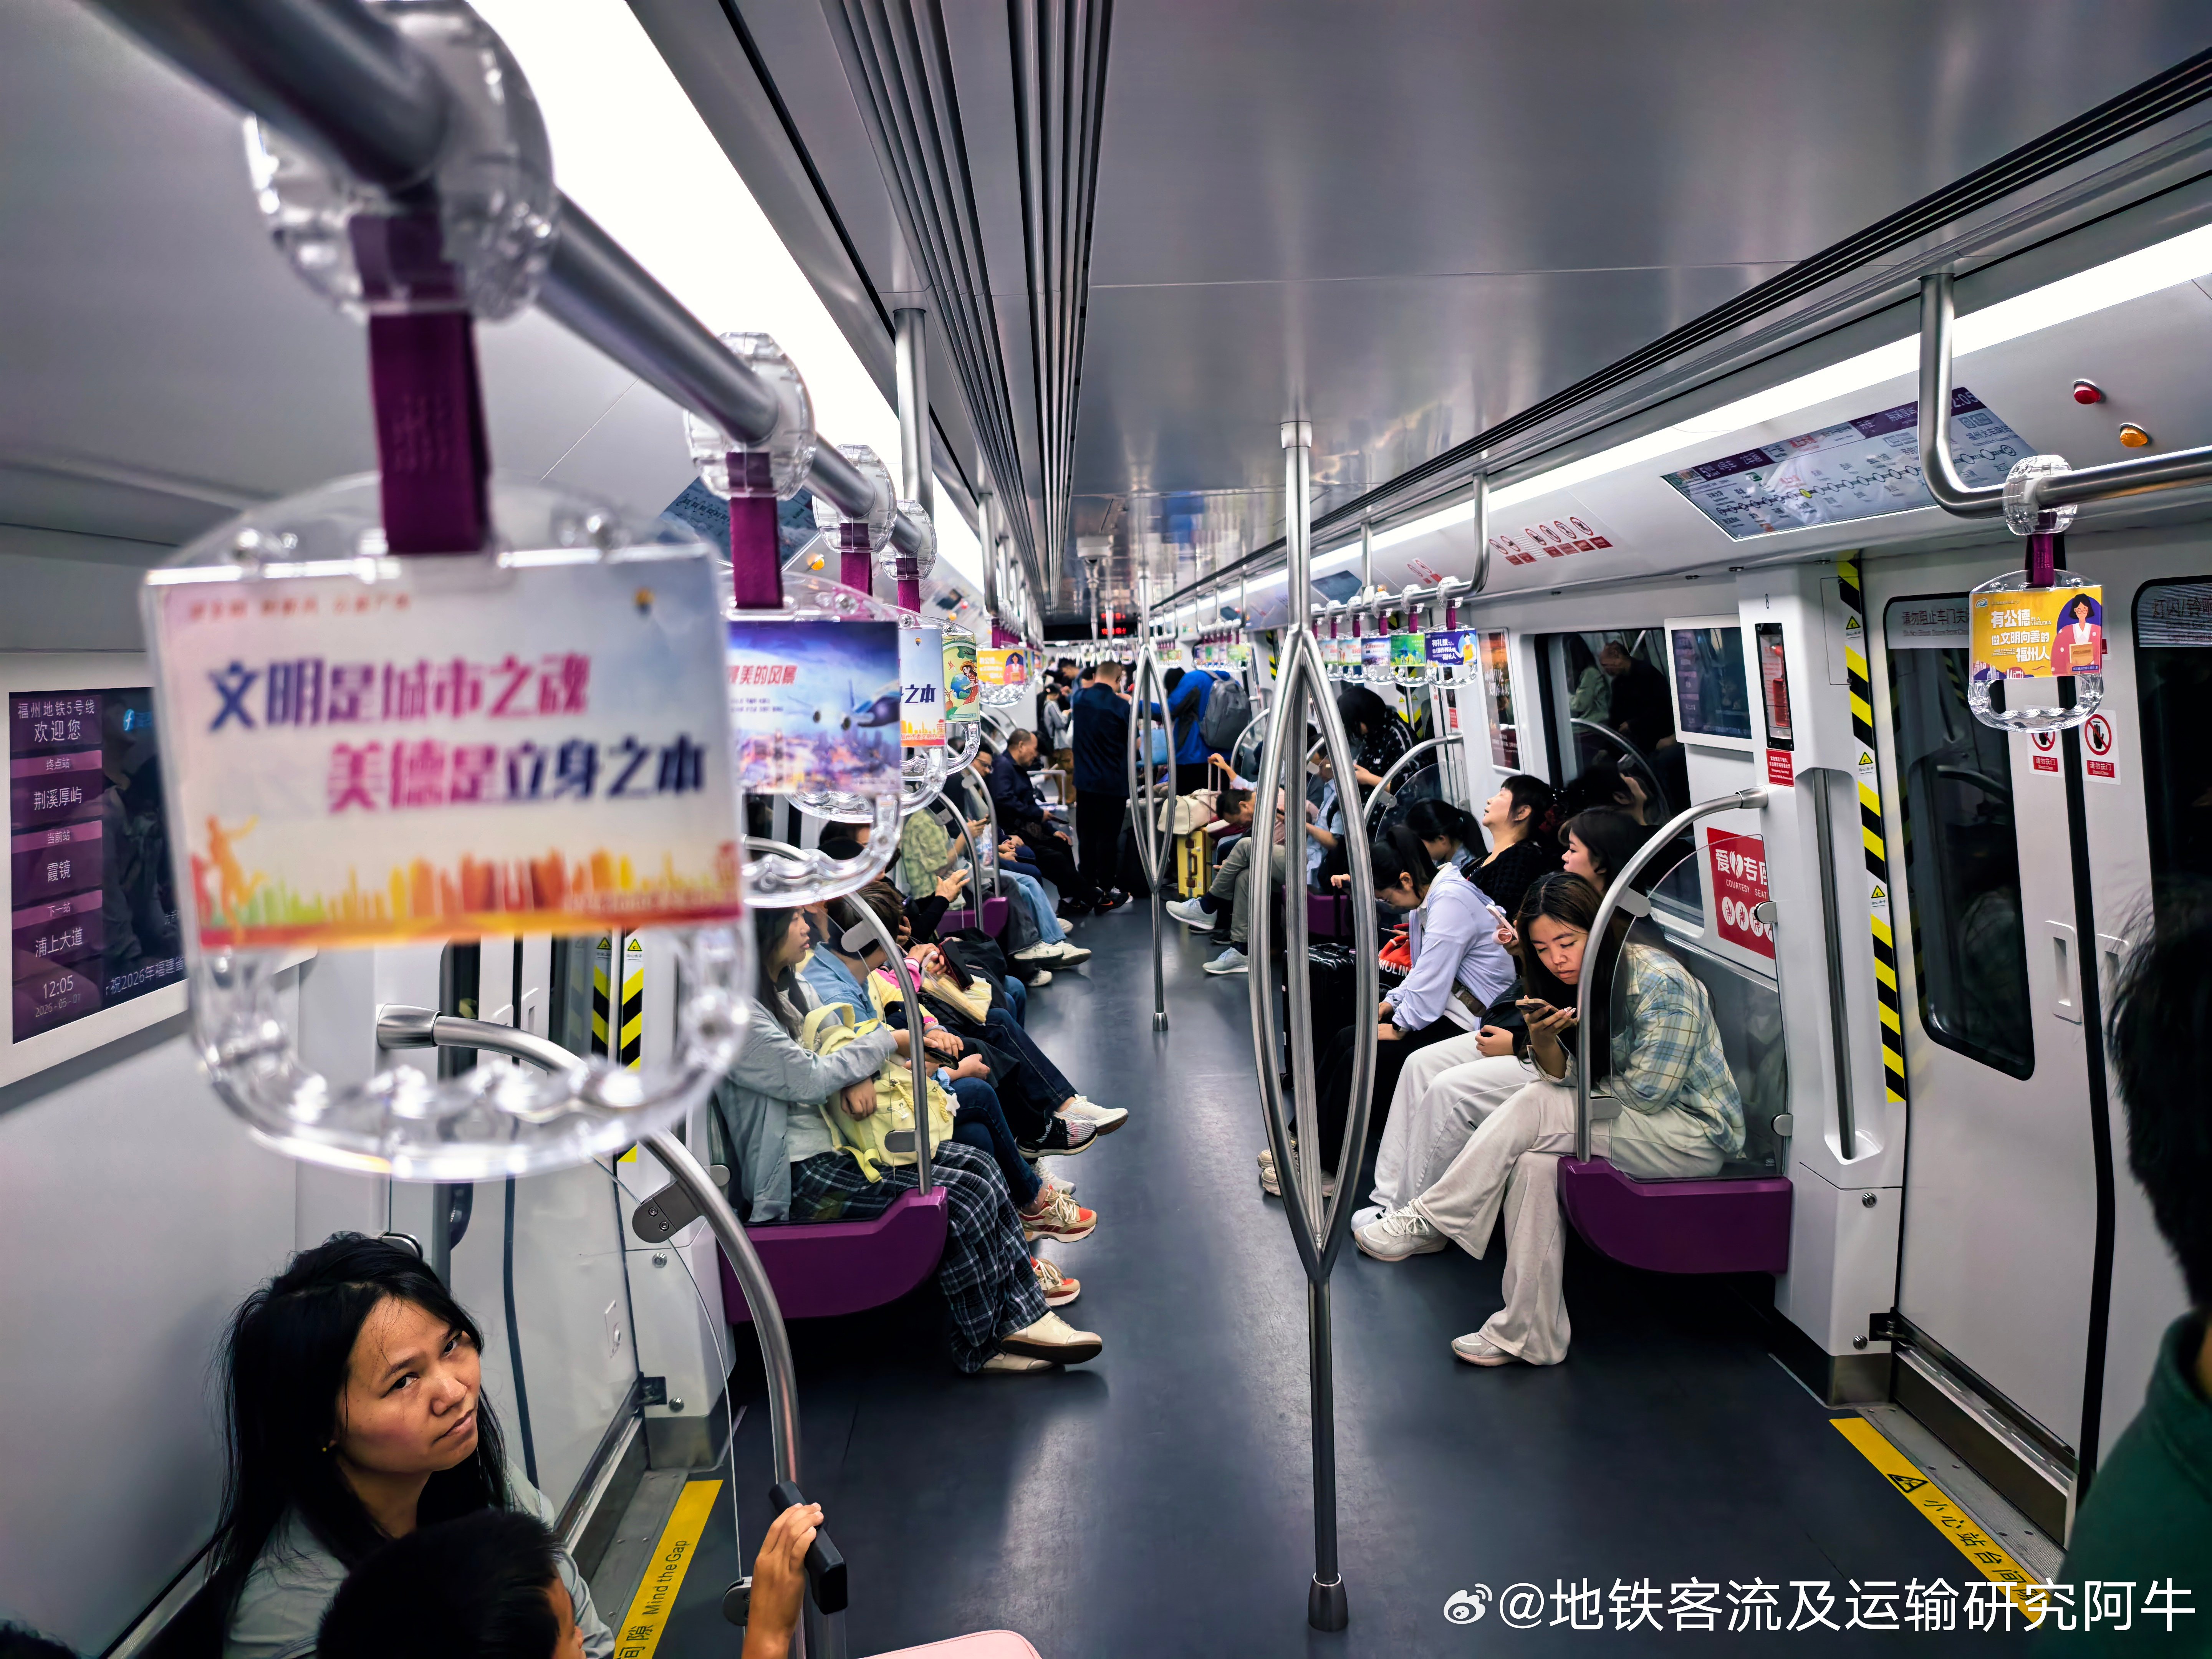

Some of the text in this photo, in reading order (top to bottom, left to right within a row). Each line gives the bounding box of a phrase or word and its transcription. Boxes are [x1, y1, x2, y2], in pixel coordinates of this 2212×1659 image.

[1951, 392, 1979, 409] 2:05
[1991, 609, 2030, 628] 有公德
[1991, 630, 2050, 646] 做文明向善的
[2016, 646, 2050, 662] 福州人
[900, 684, 936, 704] 之本
[18, 699, 95, 719] 福州地铁5号线
[34, 719, 81, 743] 欢迎您
[46, 757, 70, 770] 终点站
[33, 786, 82, 811] 荆溪厚屿
[47, 829, 71, 844] 当前站
[47, 860, 71, 883] 霞镜
[1725, 879, 1767, 899] COURTESY SEAT
[47, 901, 71, 917] 下一站
[35, 926, 83, 957] 浦上大道
[106, 955, 184, 996] 祝2026年福建省
[43, 975, 73, 999] 12:05
[642, 1540, 690, 1615] Mind the Gap
